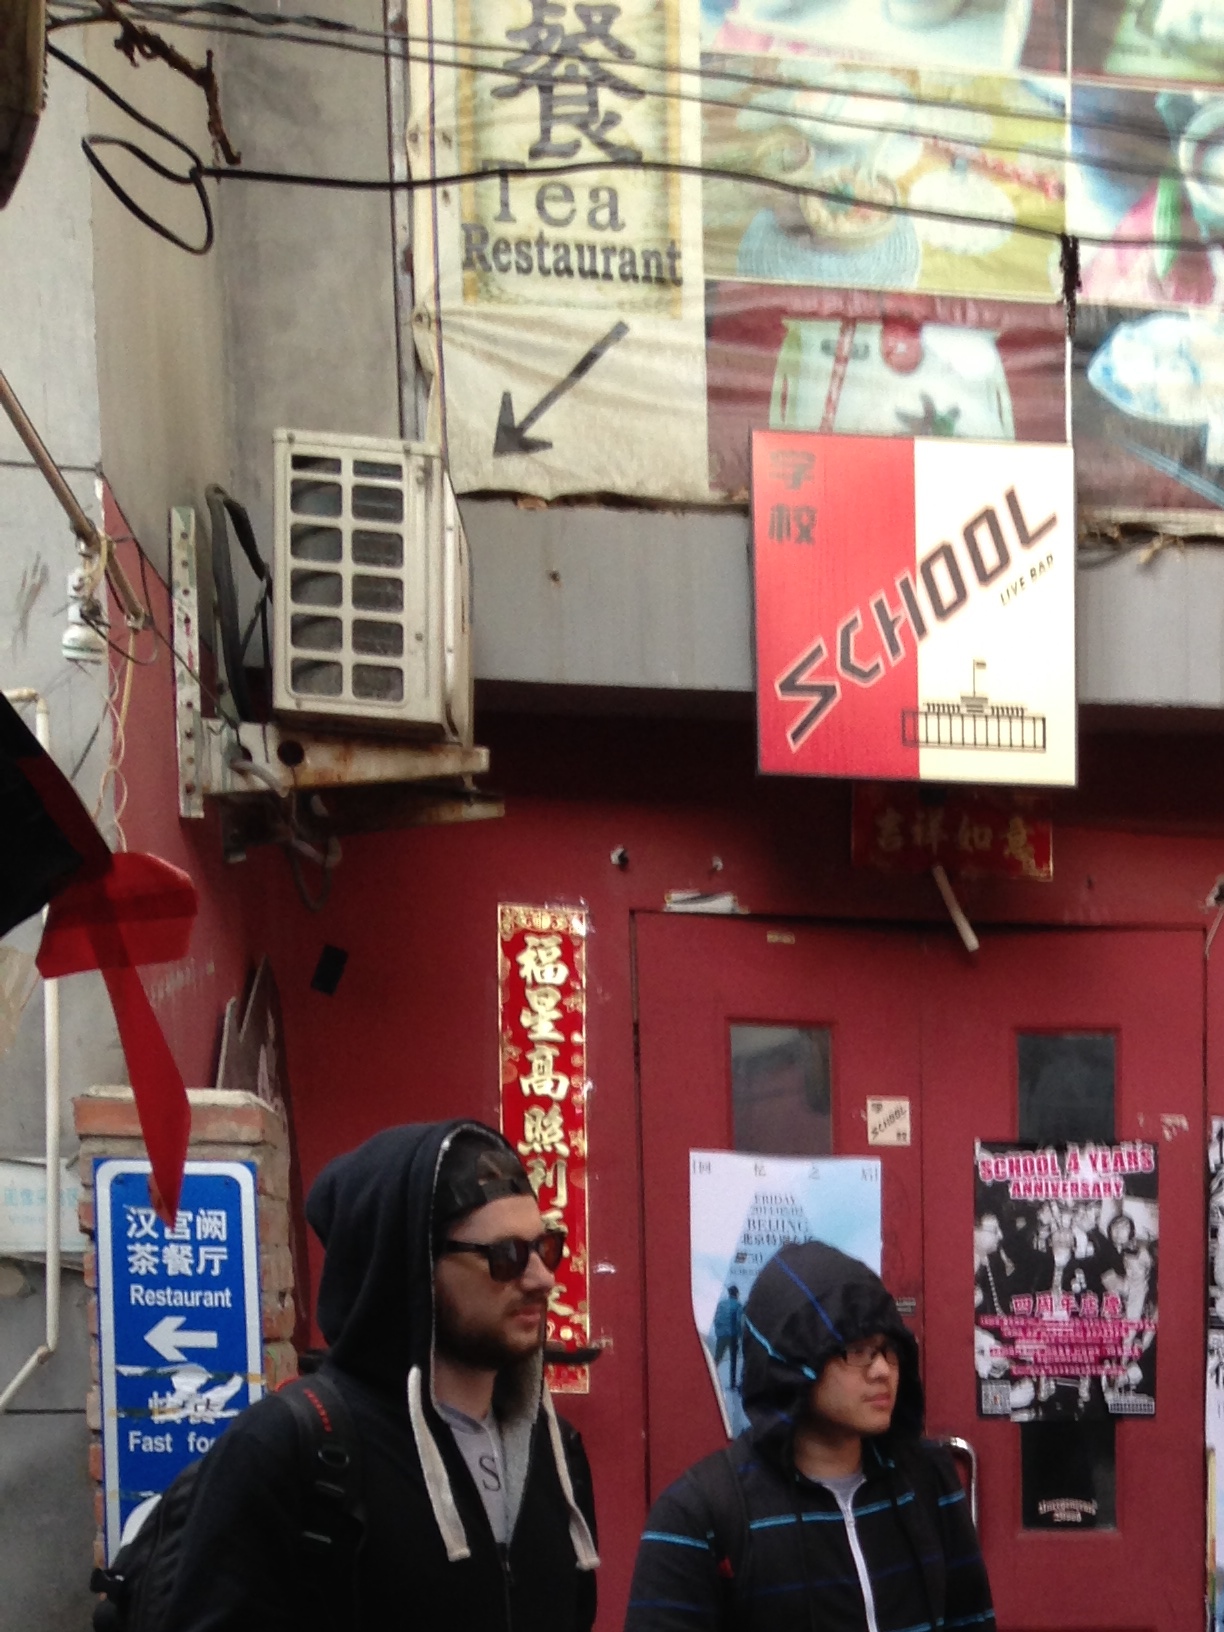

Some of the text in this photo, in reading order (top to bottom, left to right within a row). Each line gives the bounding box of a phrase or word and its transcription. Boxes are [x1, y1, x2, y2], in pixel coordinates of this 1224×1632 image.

[482, 160, 625, 231] Tea
[462, 222, 682, 286] Restaurant
[999, 552, 1055, 607] LIVE BAR
[774, 484, 1058, 754] SCHOOL
[978, 1144, 1156, 1182] SCHOOL 4 YEARS
[1010, 1177, 1125, 1199] ANNIVERSARY
[127, 1242, 229, 1277] 茶餐厅
[129, 1283, 232, 1309] Restaurant
[128, 1430, 173, 1454] Fast
